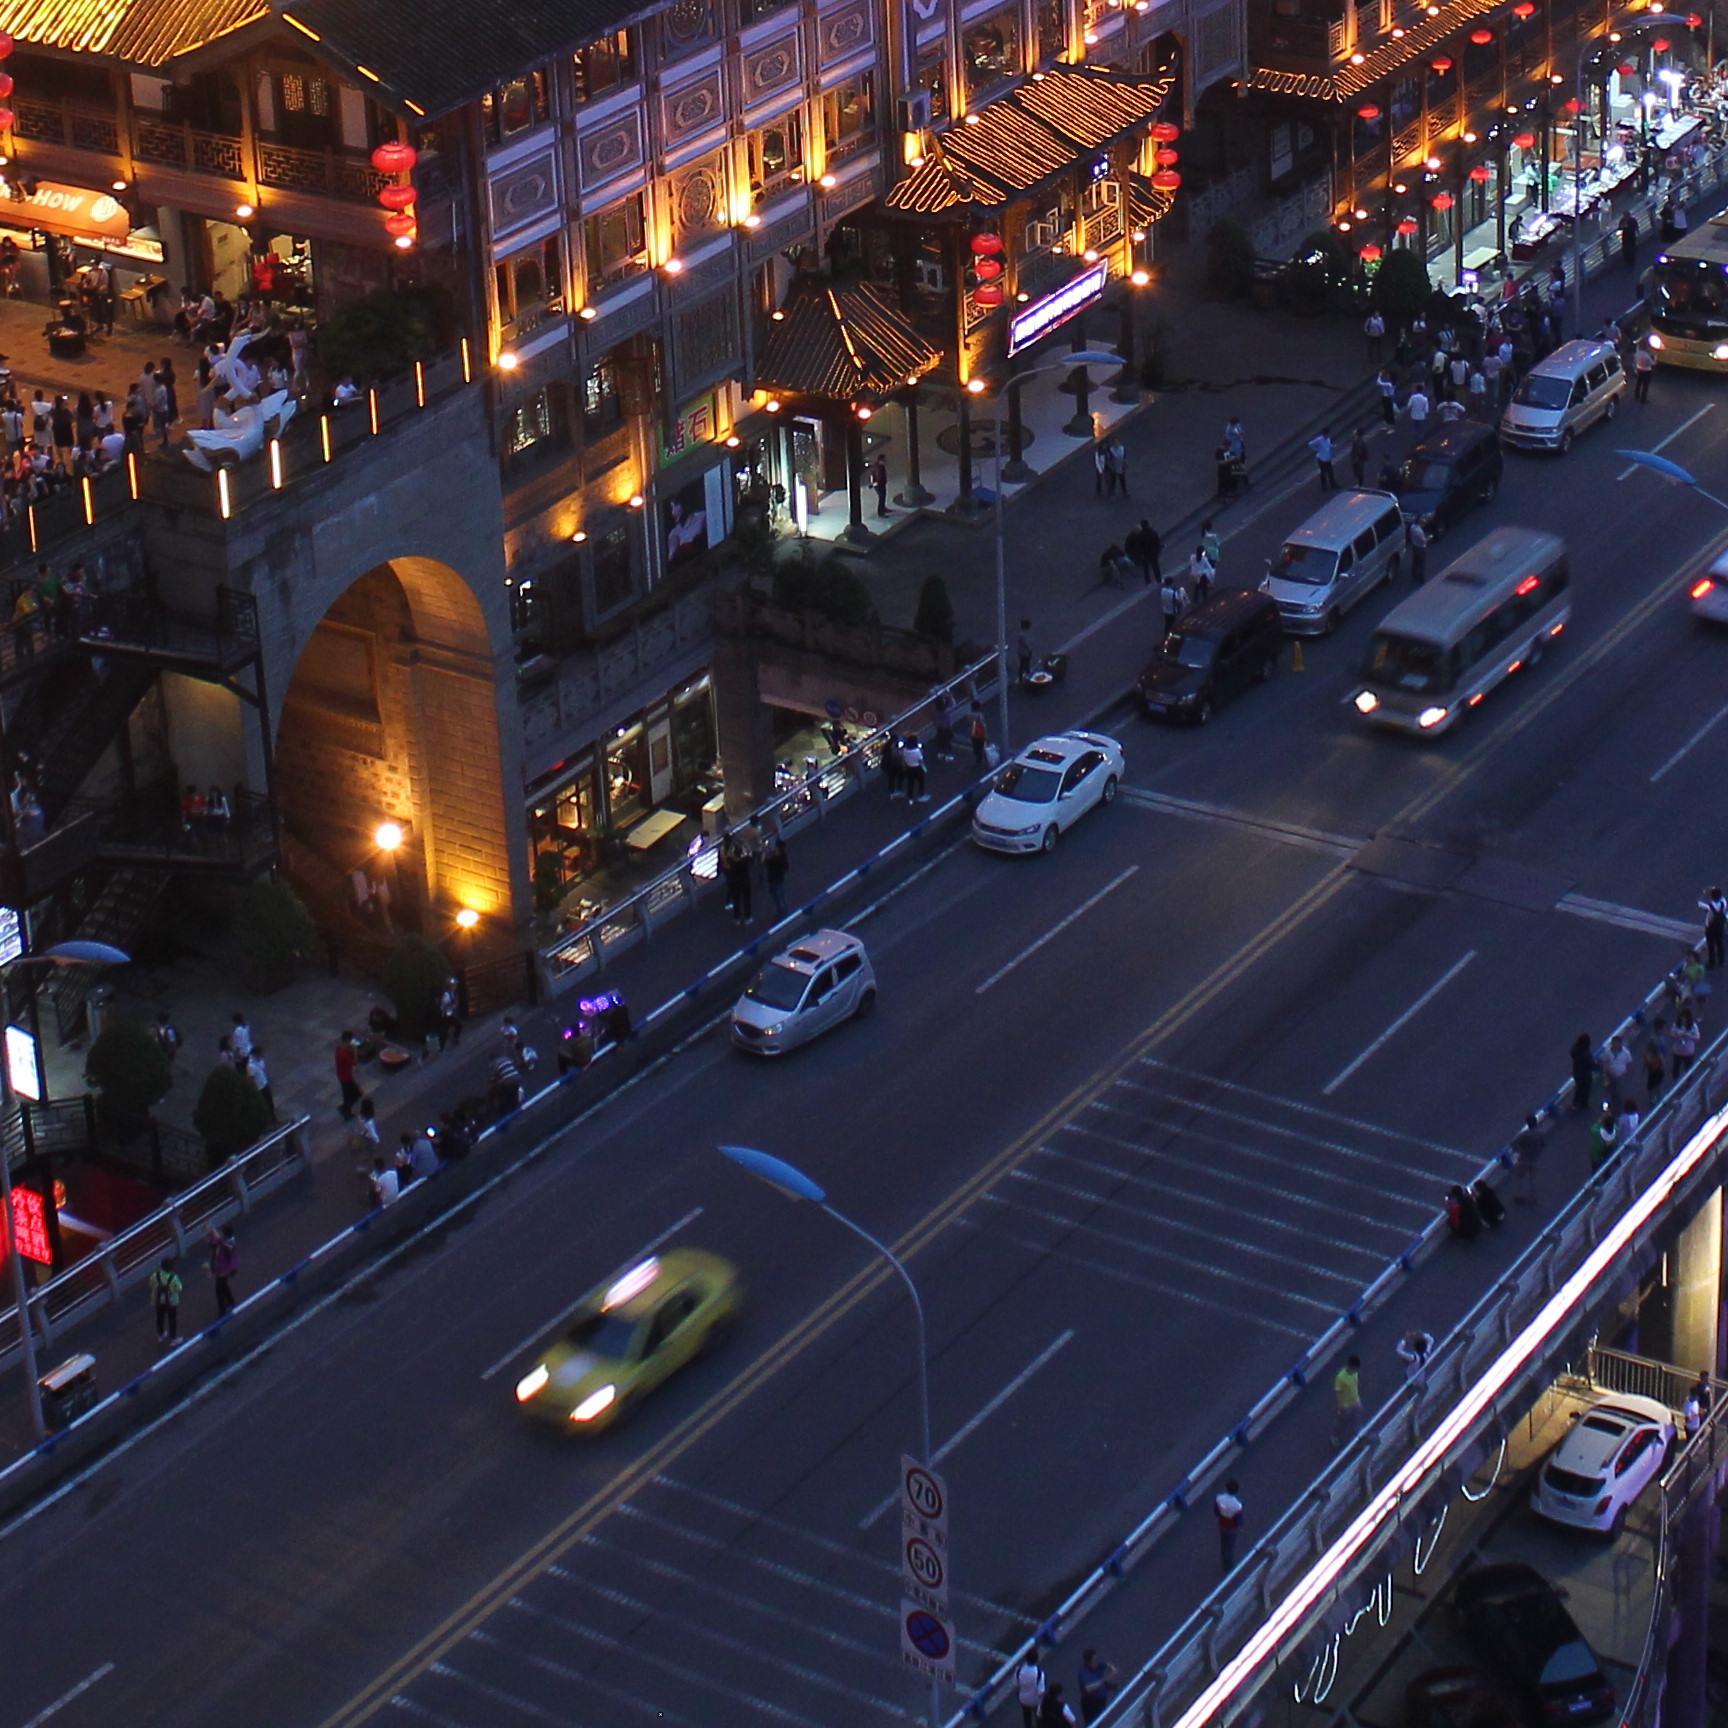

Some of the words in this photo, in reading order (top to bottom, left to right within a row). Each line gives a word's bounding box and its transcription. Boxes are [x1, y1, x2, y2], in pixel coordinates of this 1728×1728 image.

[24, 186, 85, 213] HOW
[913, 1476, 937, 1509] 70
[913, 1546, 937, 1580] 50
